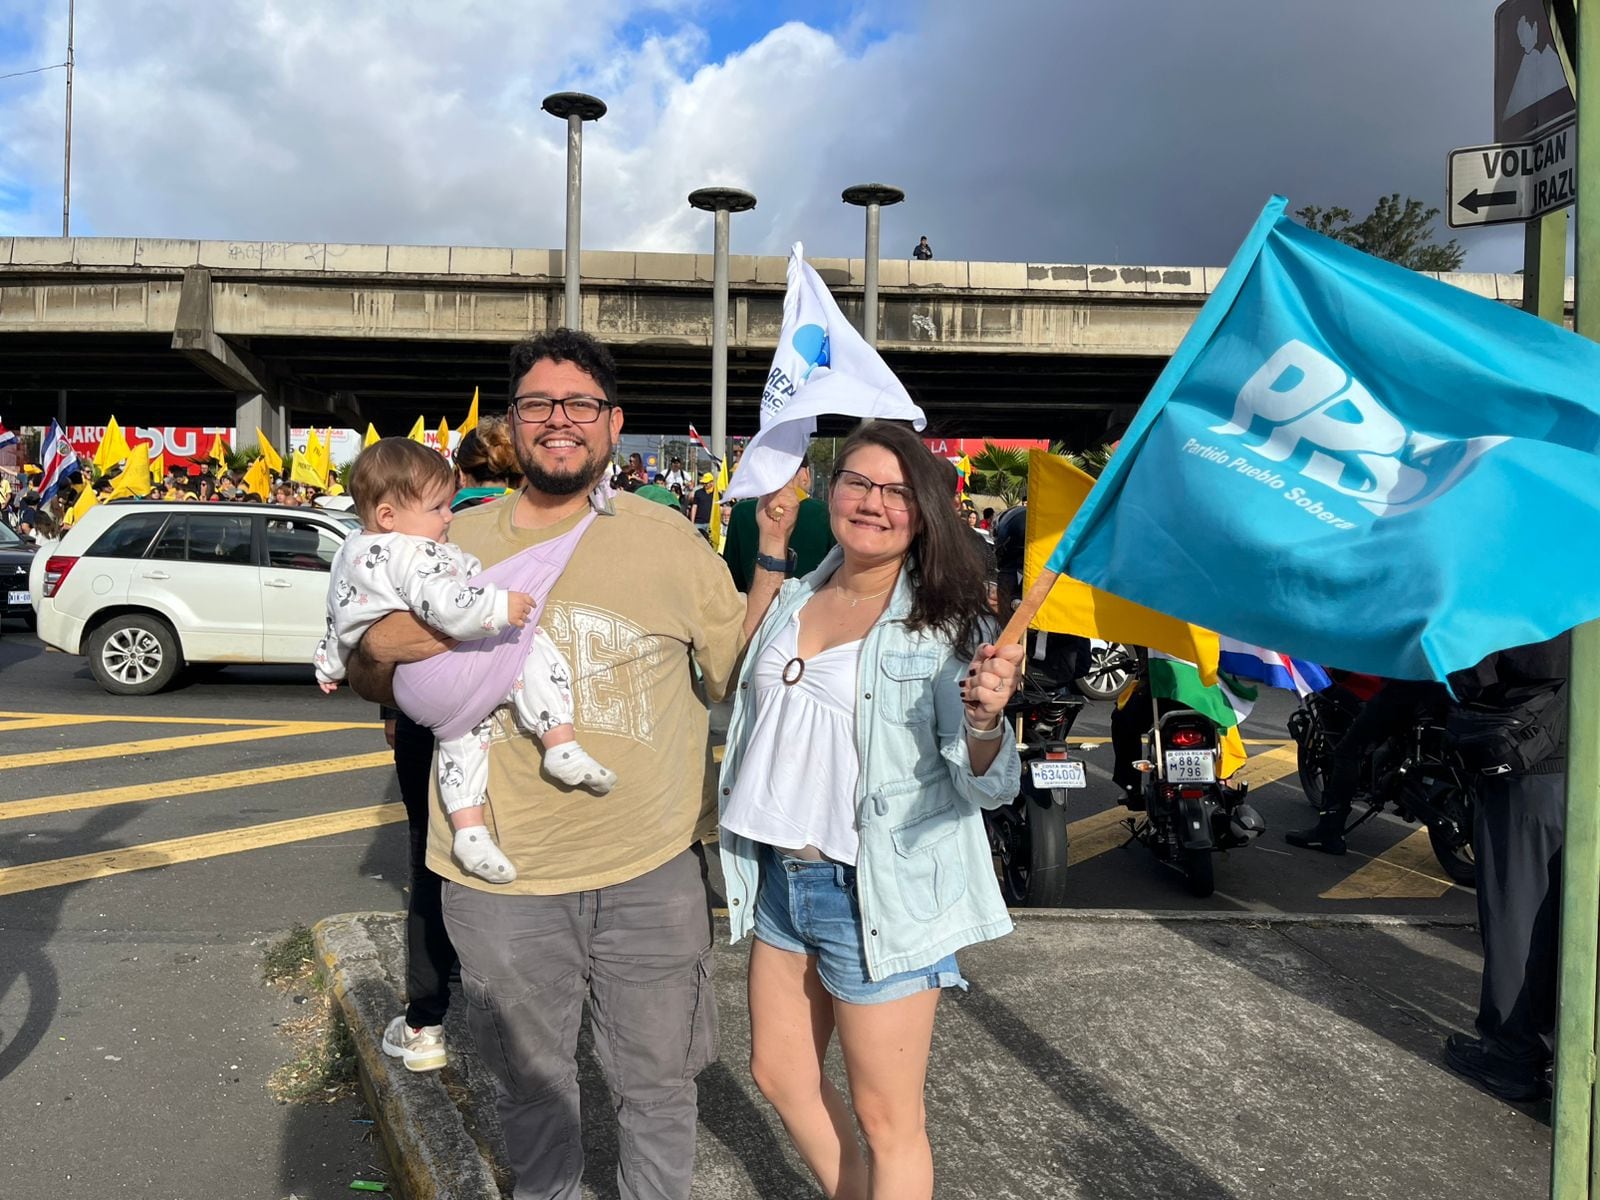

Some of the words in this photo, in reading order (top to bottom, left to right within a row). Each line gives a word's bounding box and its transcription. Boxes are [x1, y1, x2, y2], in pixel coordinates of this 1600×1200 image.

[1482, 131, 1567, 179] VOLCAN
[1182, 437, 1229, 465] Partido
[1227, 456, 1286, 490] Pueblo
[1179, 756, 1201, 766] 882
[1180, 767, 1202, 777] 796
